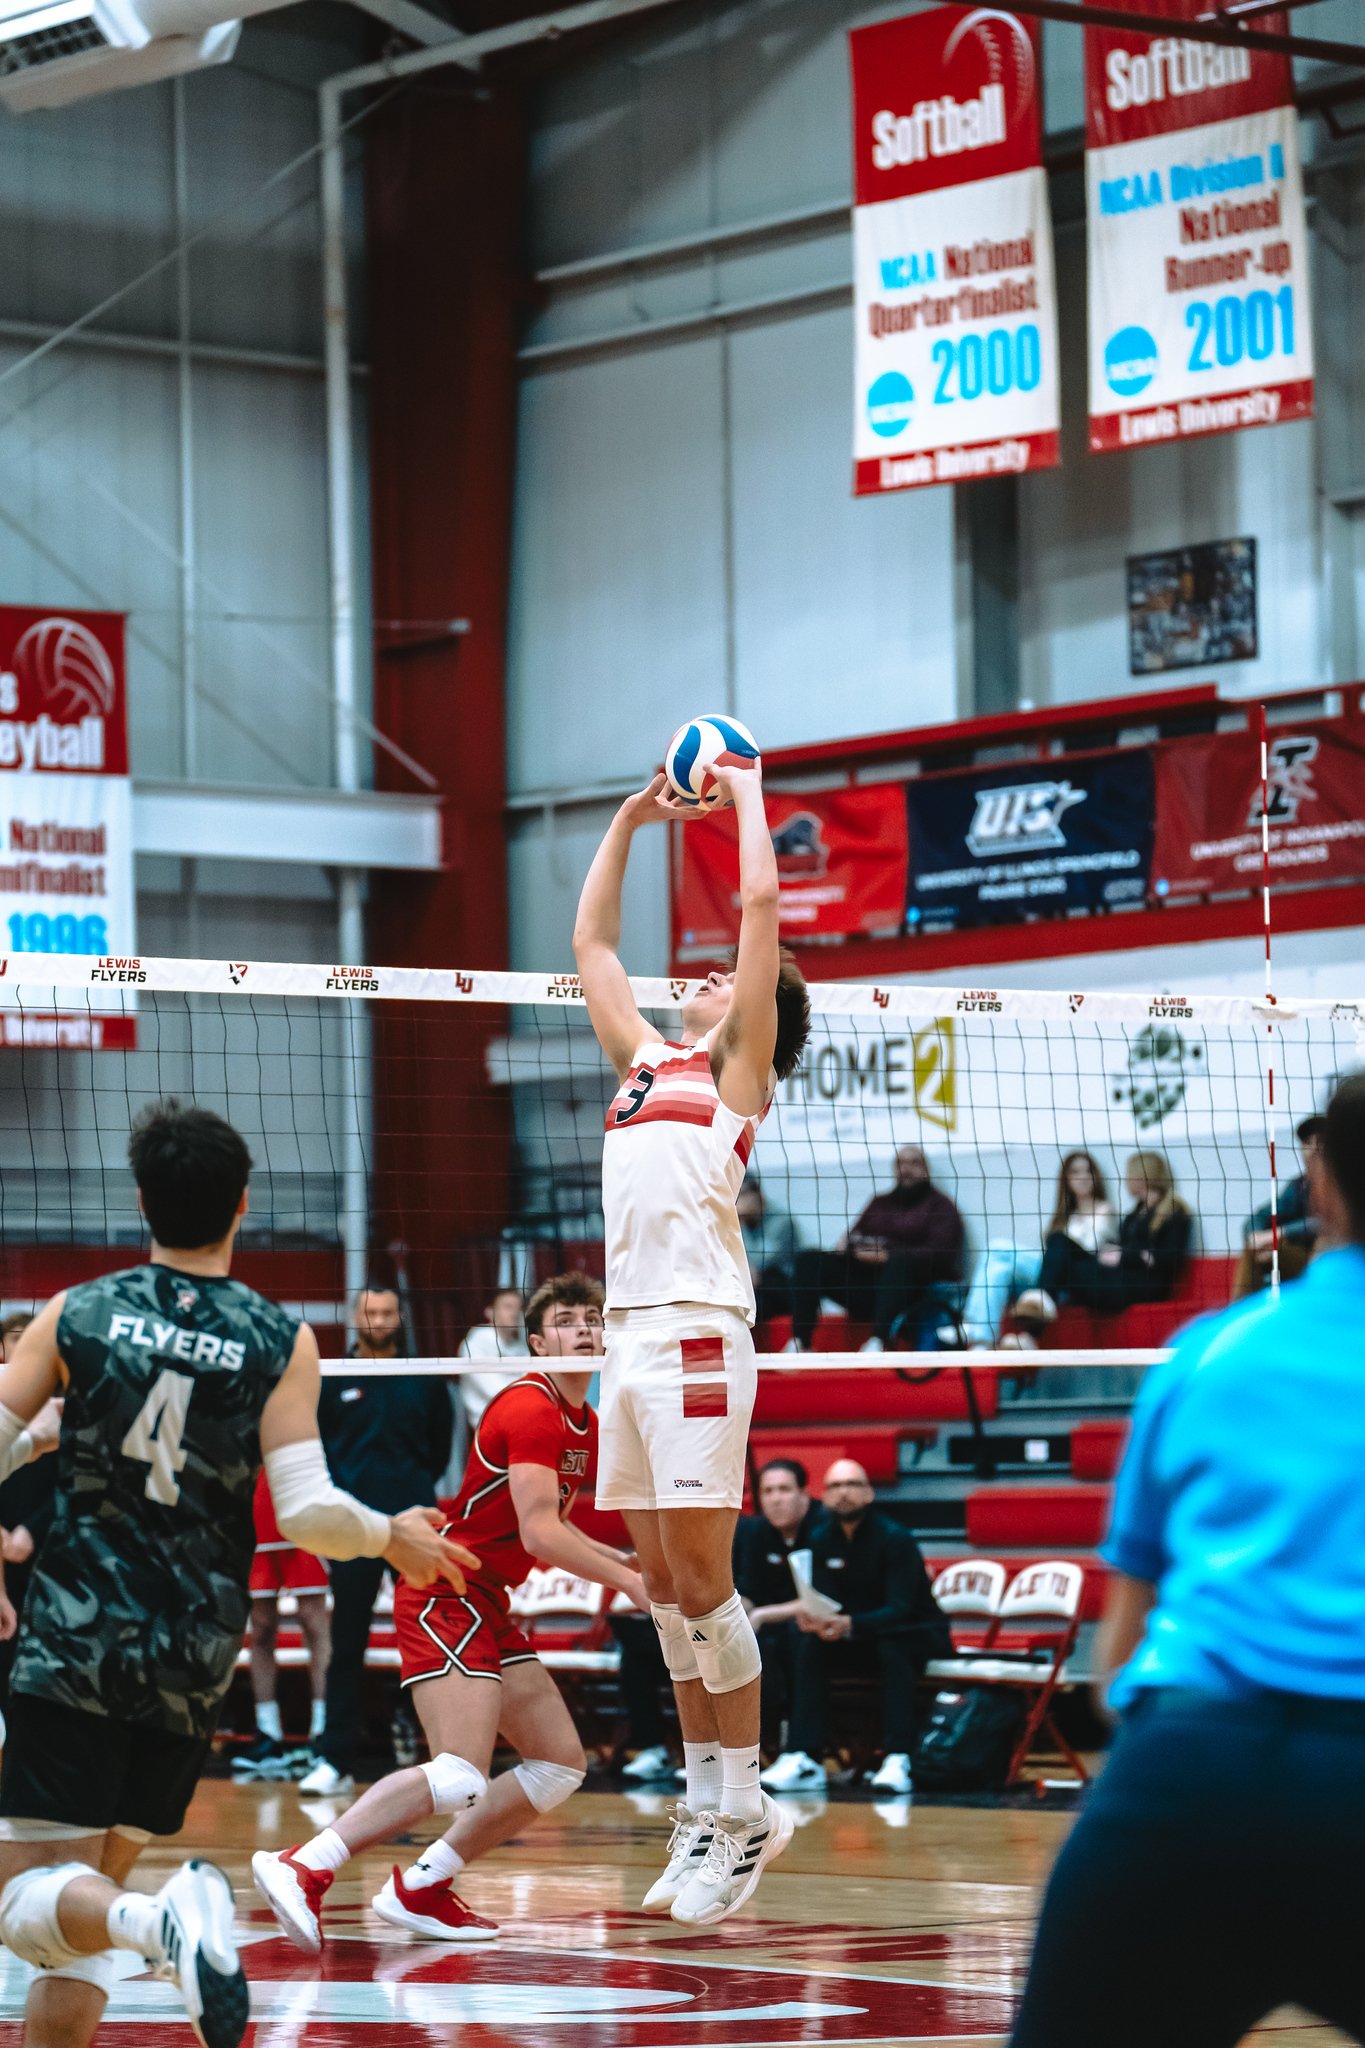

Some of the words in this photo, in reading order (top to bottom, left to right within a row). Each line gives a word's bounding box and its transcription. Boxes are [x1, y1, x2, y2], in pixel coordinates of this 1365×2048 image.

[871, 82, 1007, 170] Softball
[1169, 153, 1265, 202] Division
[1179, 189, 1281, 245] National
[880, 250, 936, 290] NCAA
[943, 230, 1036, 281] National
[1164, 241, 1293, 294] Runner-up
[868, 274, 1040, 340] Quarterfinalist
[1185, 285, 1295, 371] 2001
[932, 324, 1041, 404] 2000
[1119, 406, 1178, 444] Lewis
[1178, 390, 1282, 433] University
[879, 451, 934, 488] Lewis
[934, 437, 1031, 481] University
[9, 818, 107, 857] National
[90, 969, 148, 983] FLYERS
[98, 958, 141, 970] LEWIS
[325, 978, 380, 992] FLYERS
[332, 966, 374, 979] LEWIS
[553, 975, 582, 987] LEW
[956, 1000, 1003, 1013] FLYERS
[962, 990, 998, 1001] LEWIS
[1148, 1006, 1194, 1019] FLYERS
[1152, 996, 1188, 1007] LEWIS
[614, 1067, 655, 1125] 3
[107, 1312, 247, 1373] FLYERS
[120, 1367, 195, 1508] 4
